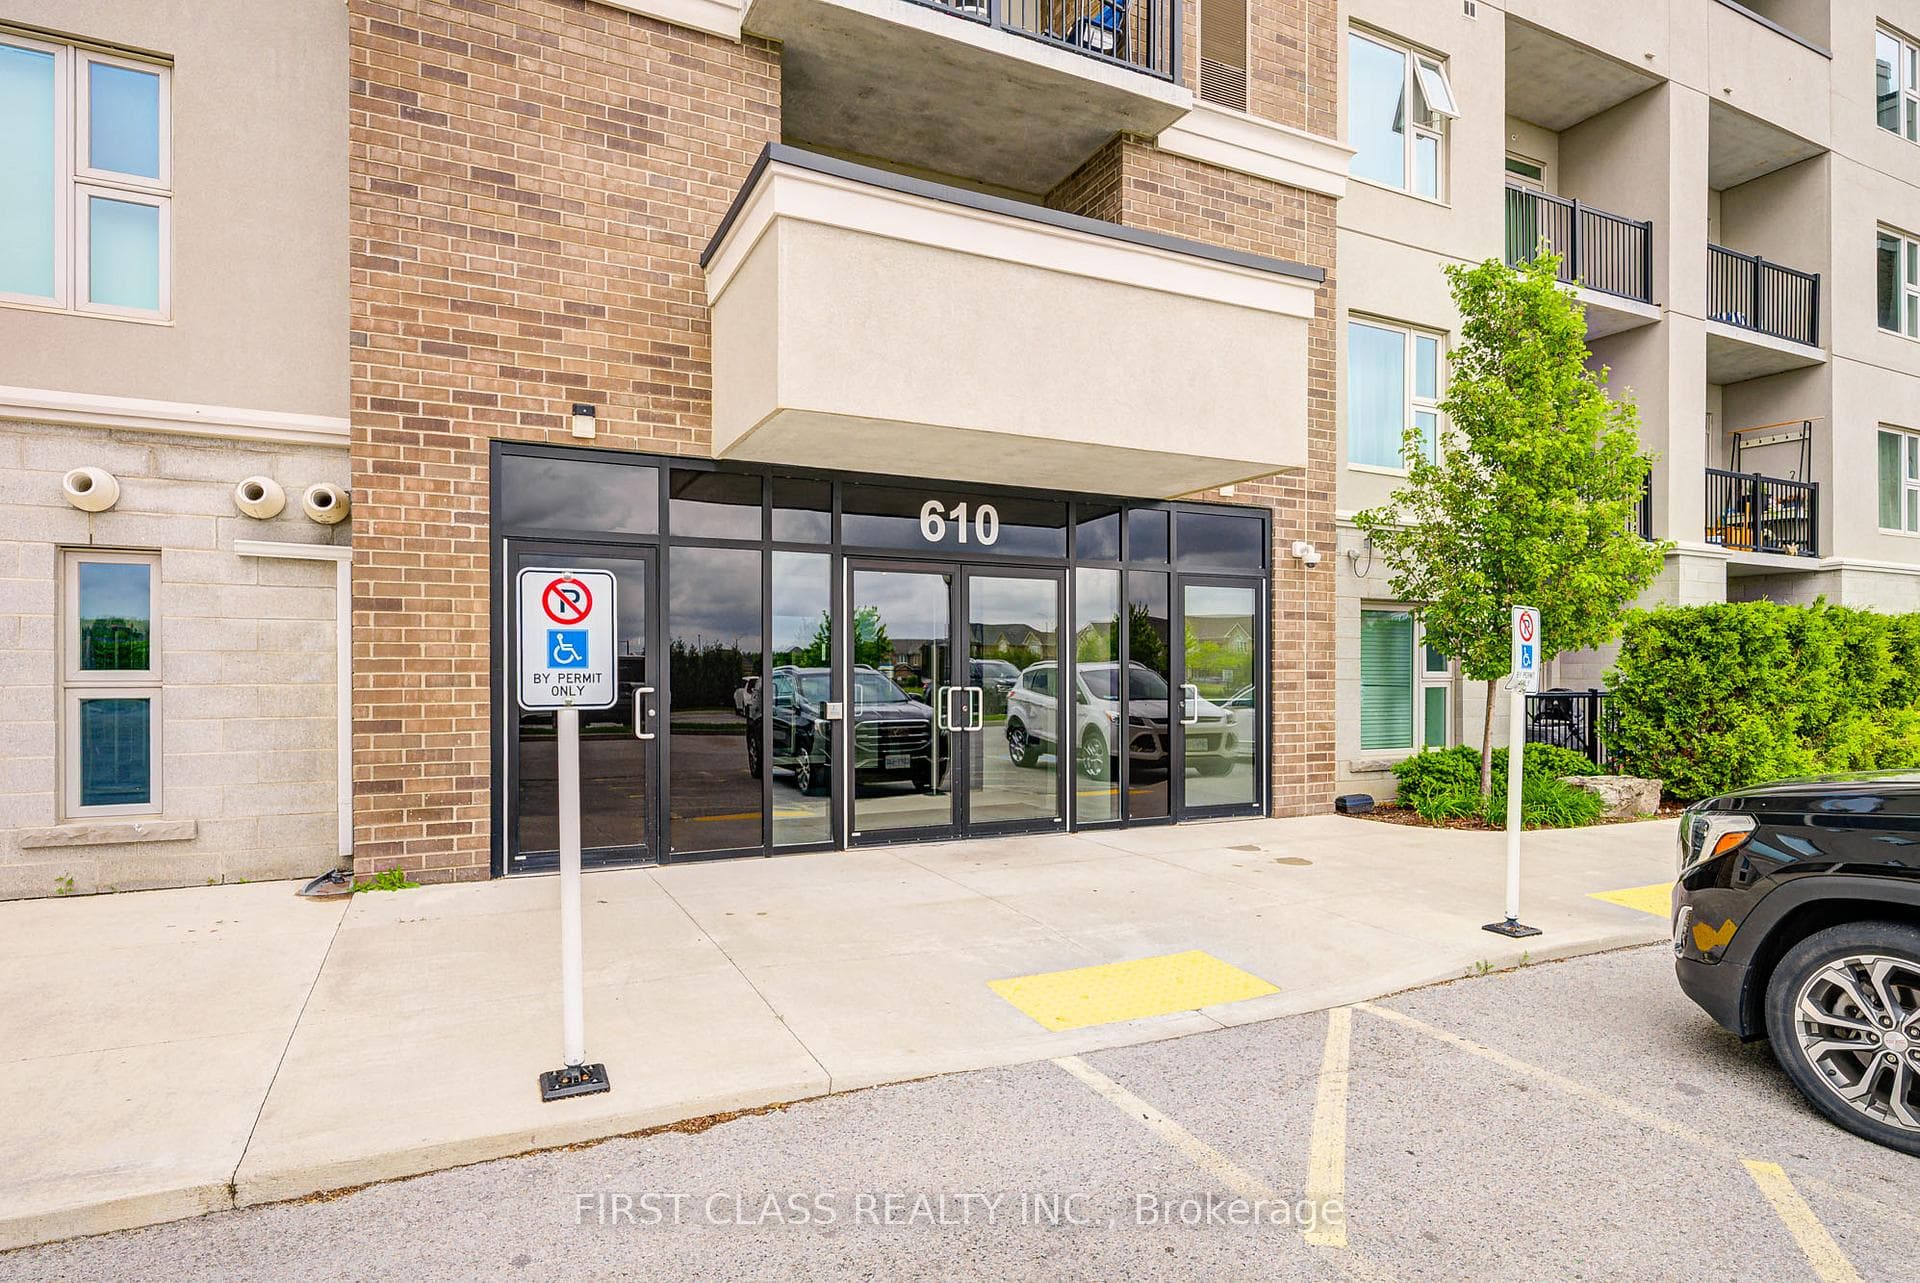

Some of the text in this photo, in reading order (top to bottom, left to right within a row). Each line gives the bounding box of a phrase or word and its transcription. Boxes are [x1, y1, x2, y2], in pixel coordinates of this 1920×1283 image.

[920, 500, 999, 545] 610
[533, 673, 602, 684] BY PERMIT
[551, 685, 585, 696] ONLY
